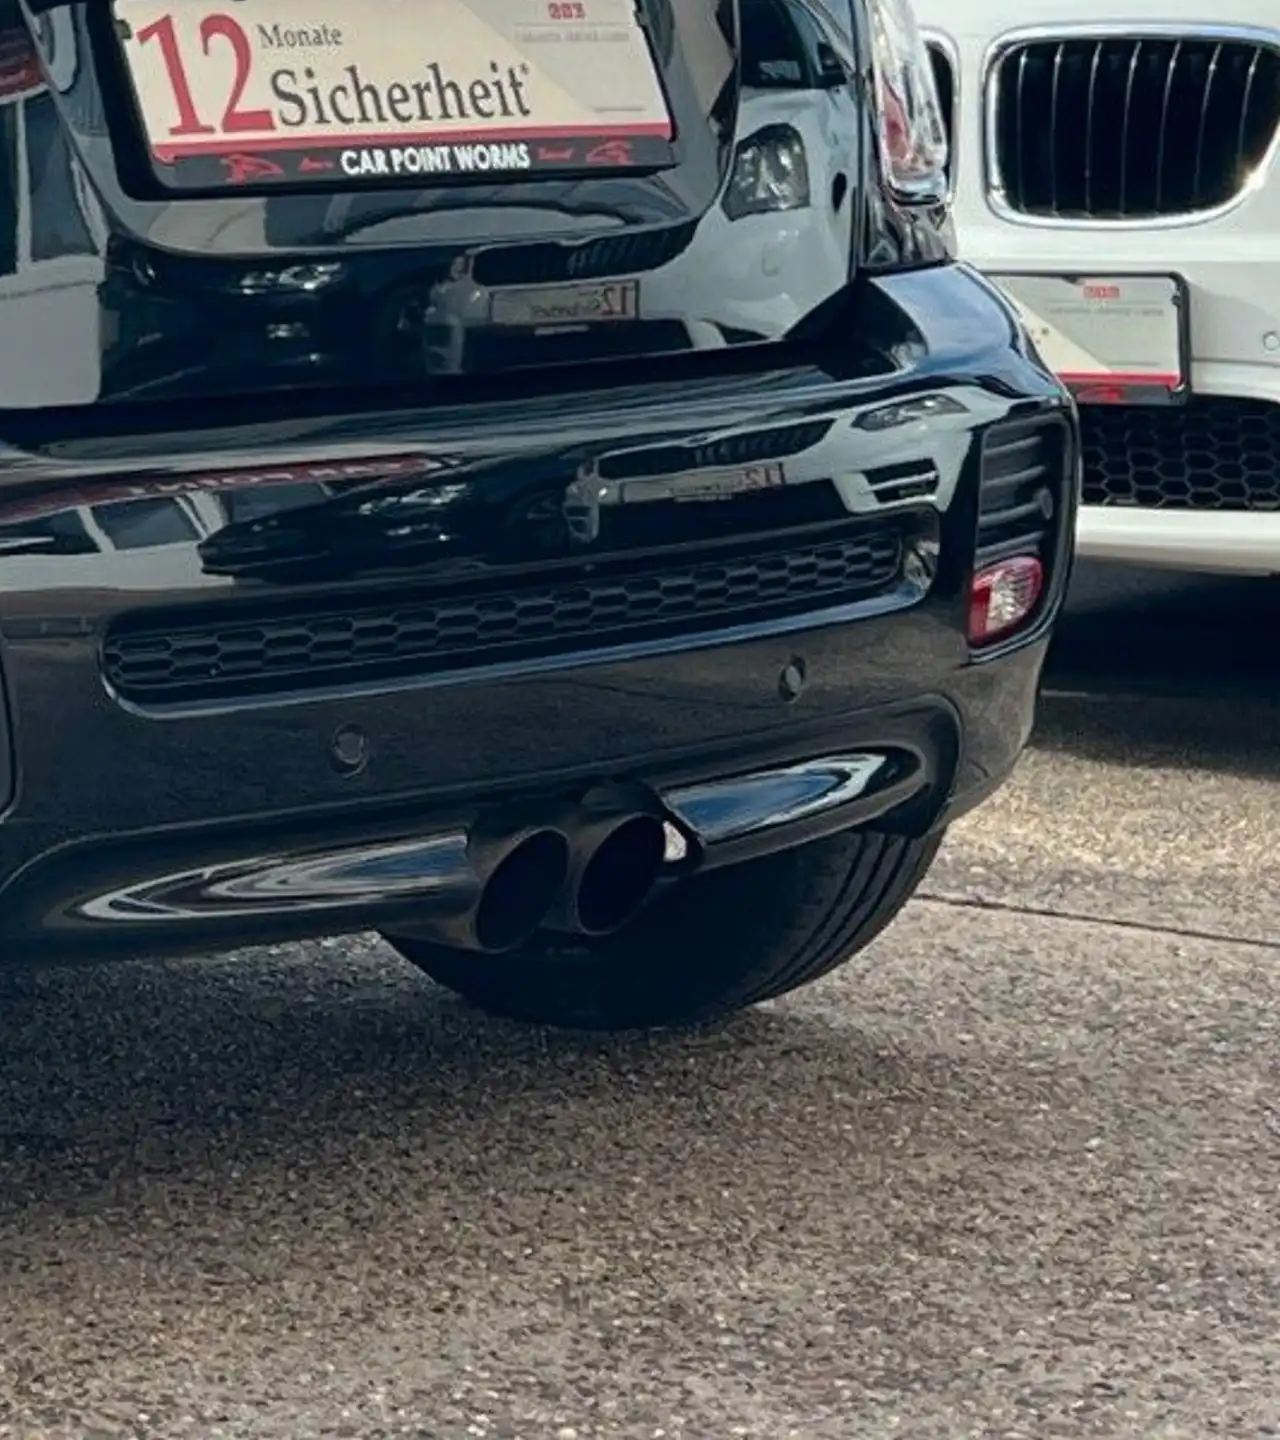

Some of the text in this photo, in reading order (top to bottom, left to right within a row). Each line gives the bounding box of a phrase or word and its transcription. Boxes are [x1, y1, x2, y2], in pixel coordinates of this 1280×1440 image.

[136, 14, 342, 135] 12 Monate
[341, 150, 389, 174] CAR
[391, 146, 452, 173] POINT
[453, 143, 531, 171] WORMS
